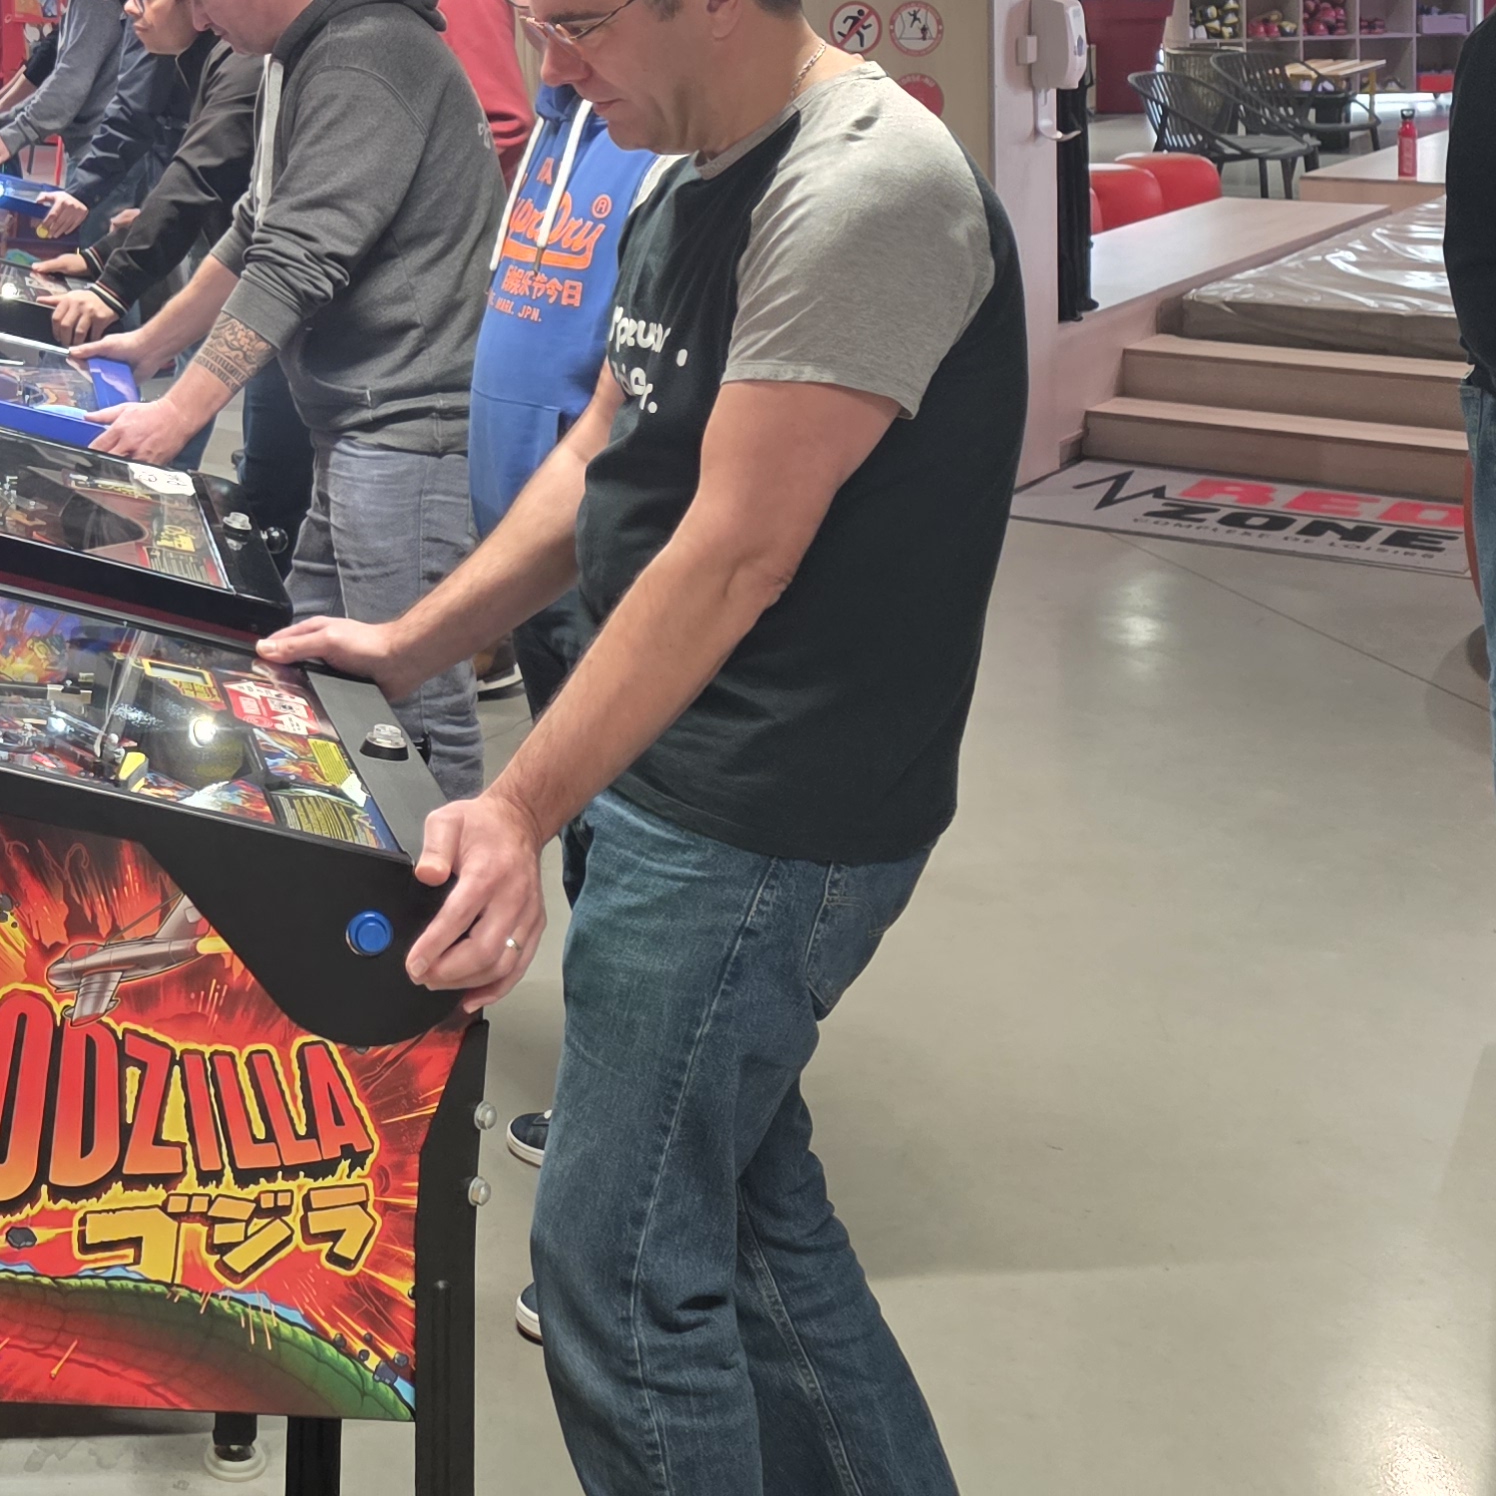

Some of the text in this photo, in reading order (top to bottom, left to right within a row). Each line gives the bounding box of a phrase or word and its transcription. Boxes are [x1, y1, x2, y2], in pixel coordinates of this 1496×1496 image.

[1133, 518, 1271, 539] COMPLEXE
[1142, 502, 1460, 553] ZONE
[1178, 479, 1464, 528] RED
[82, 1183, 378, 1284] ゴジラ
